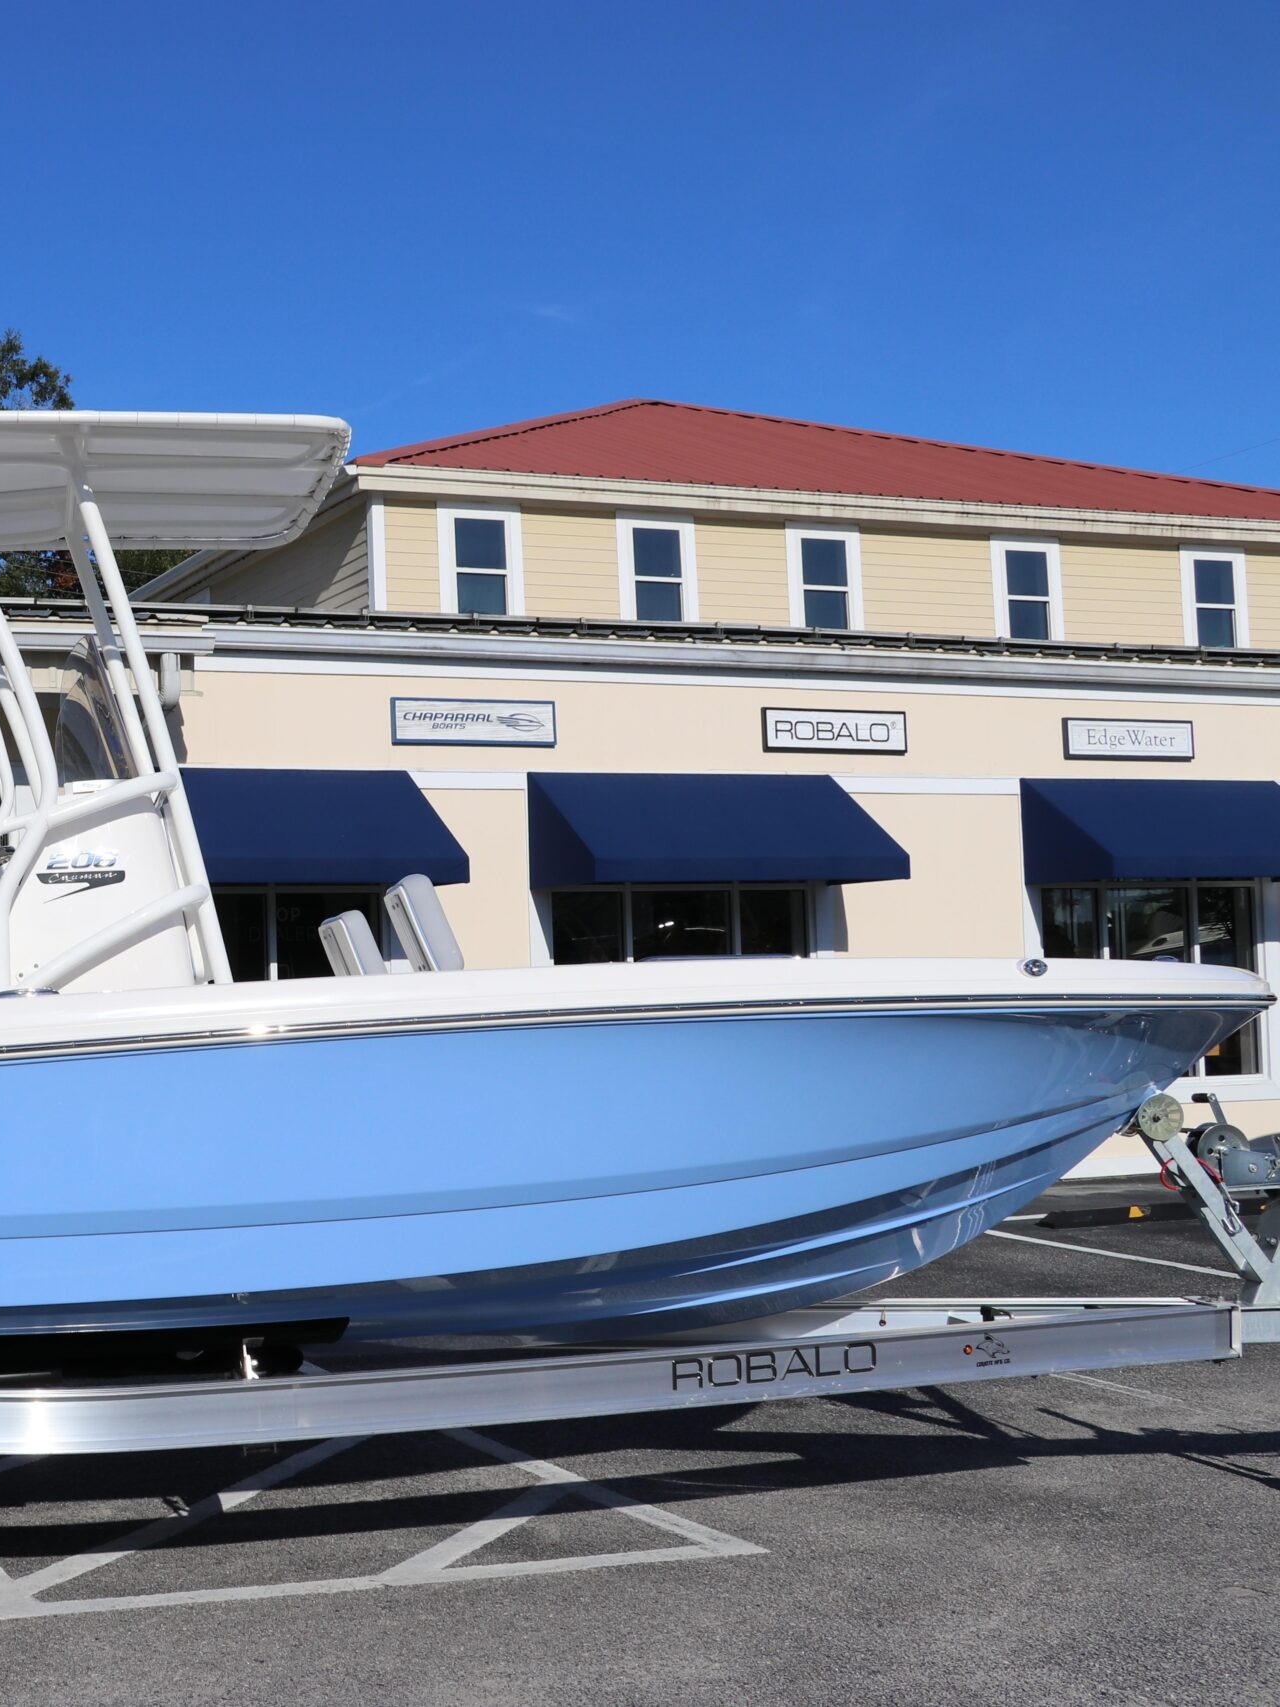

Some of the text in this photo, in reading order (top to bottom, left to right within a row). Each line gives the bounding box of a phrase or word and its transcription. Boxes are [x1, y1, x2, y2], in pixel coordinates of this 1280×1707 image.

[403, 711, 494, 723] CHAPARRAL
[431, 722, 466, 730] BOATS
[774, 720, 890, 742] ROBALO
[1086, 728, 1176, 749] EdgeWater
[671, 1341, 878, 1391] ROBALO
